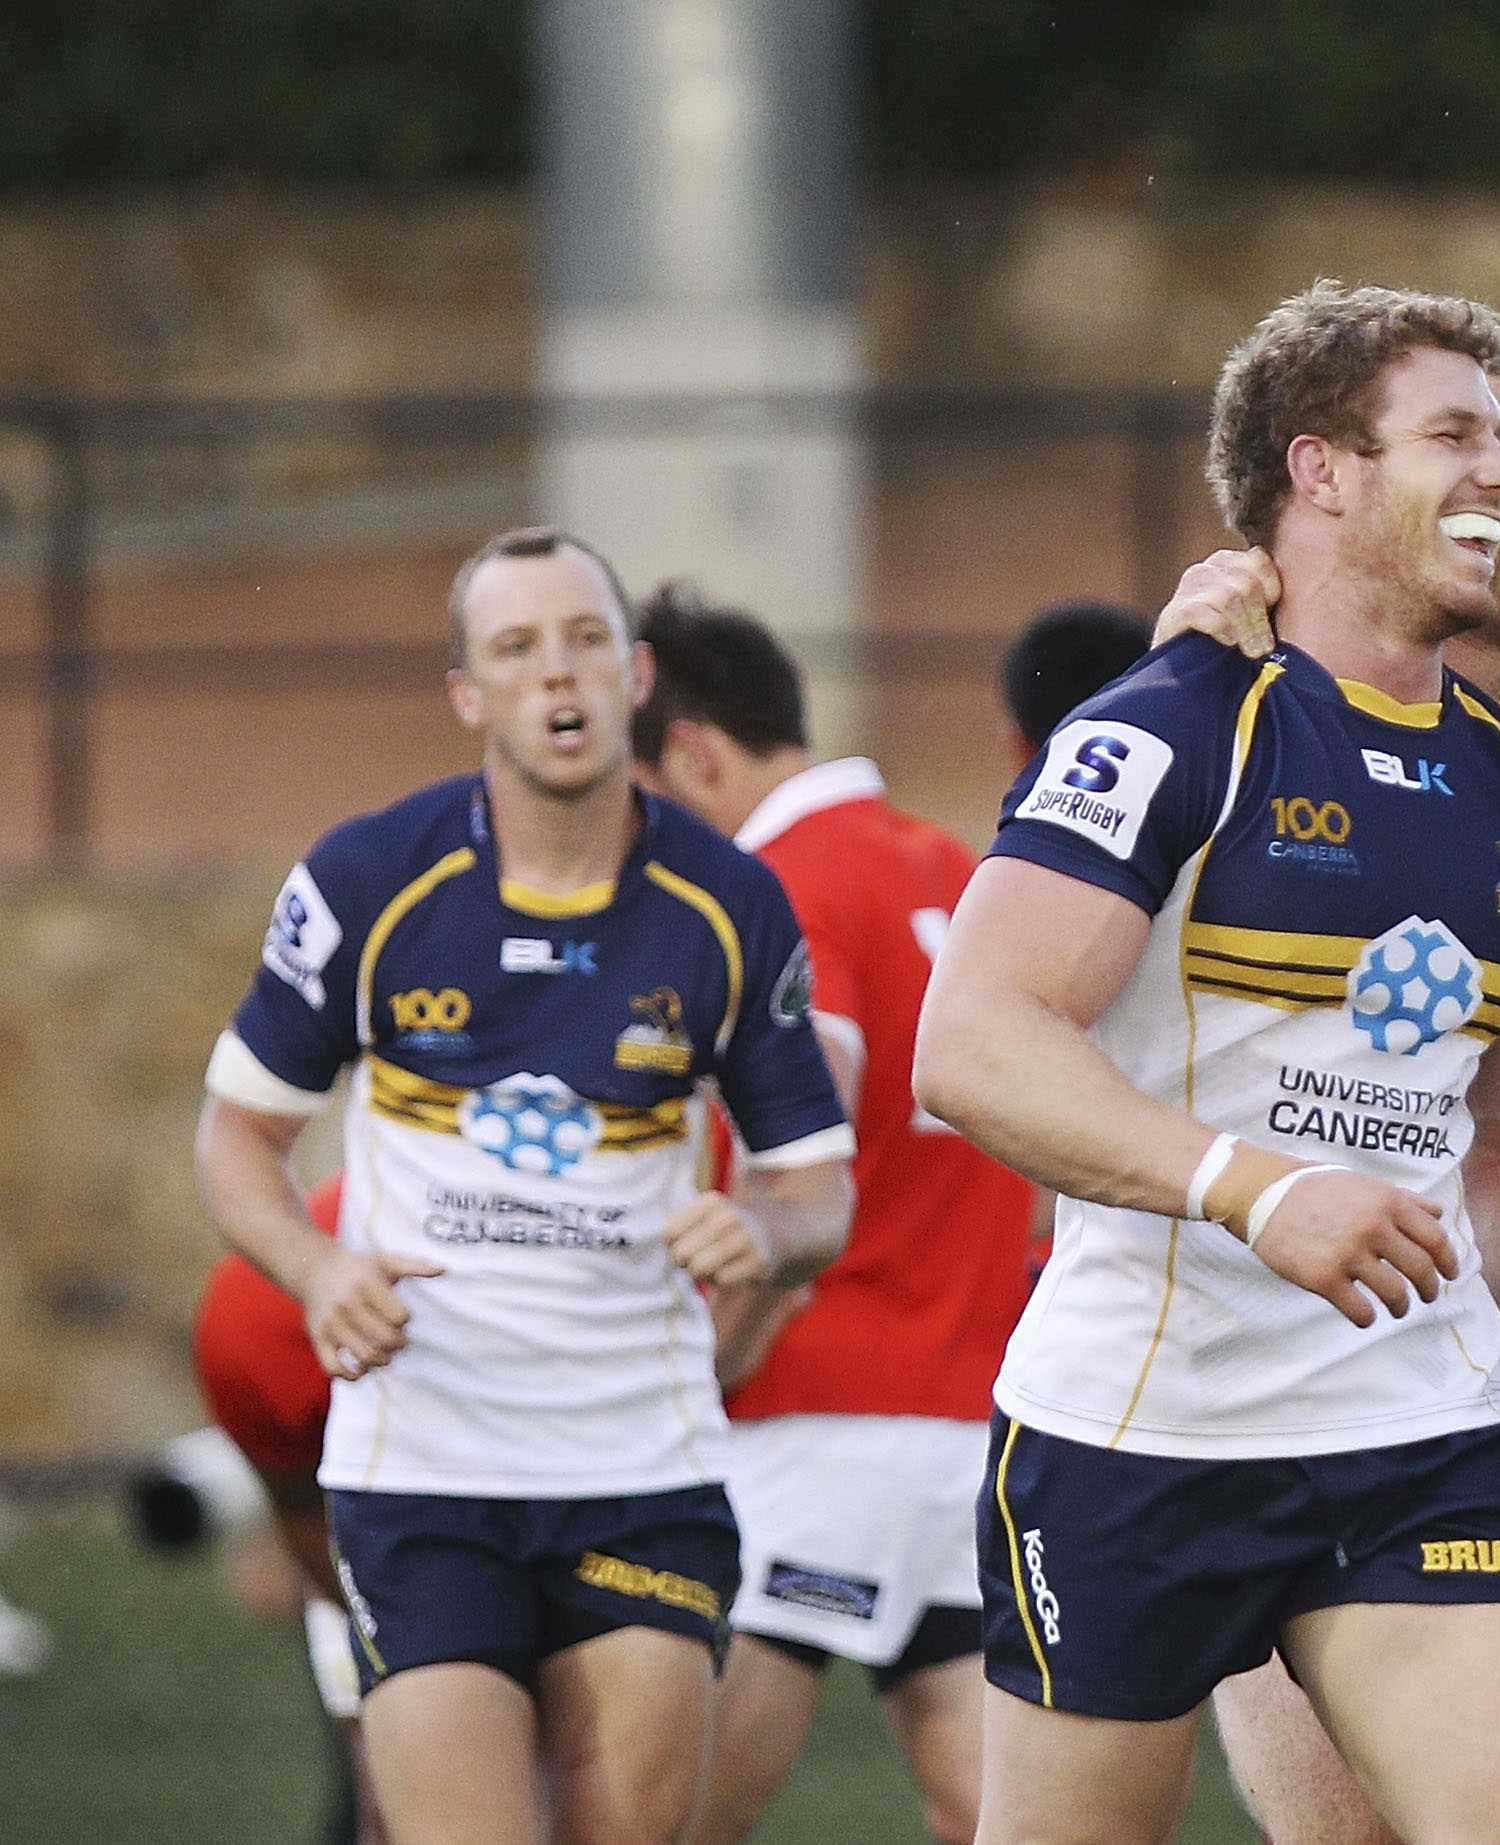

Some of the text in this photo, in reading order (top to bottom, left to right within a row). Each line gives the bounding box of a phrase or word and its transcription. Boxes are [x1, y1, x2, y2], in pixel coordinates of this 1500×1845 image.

[1360, 748, 1456, 797] BLK
[1269, 796, 1352, 844] 100
[389, 986, 473, 1032] 100
[1279, 1065, 1440, 1115] UNIVERSITY
[1269, 1100, 1457, 1159] CANBERRA
